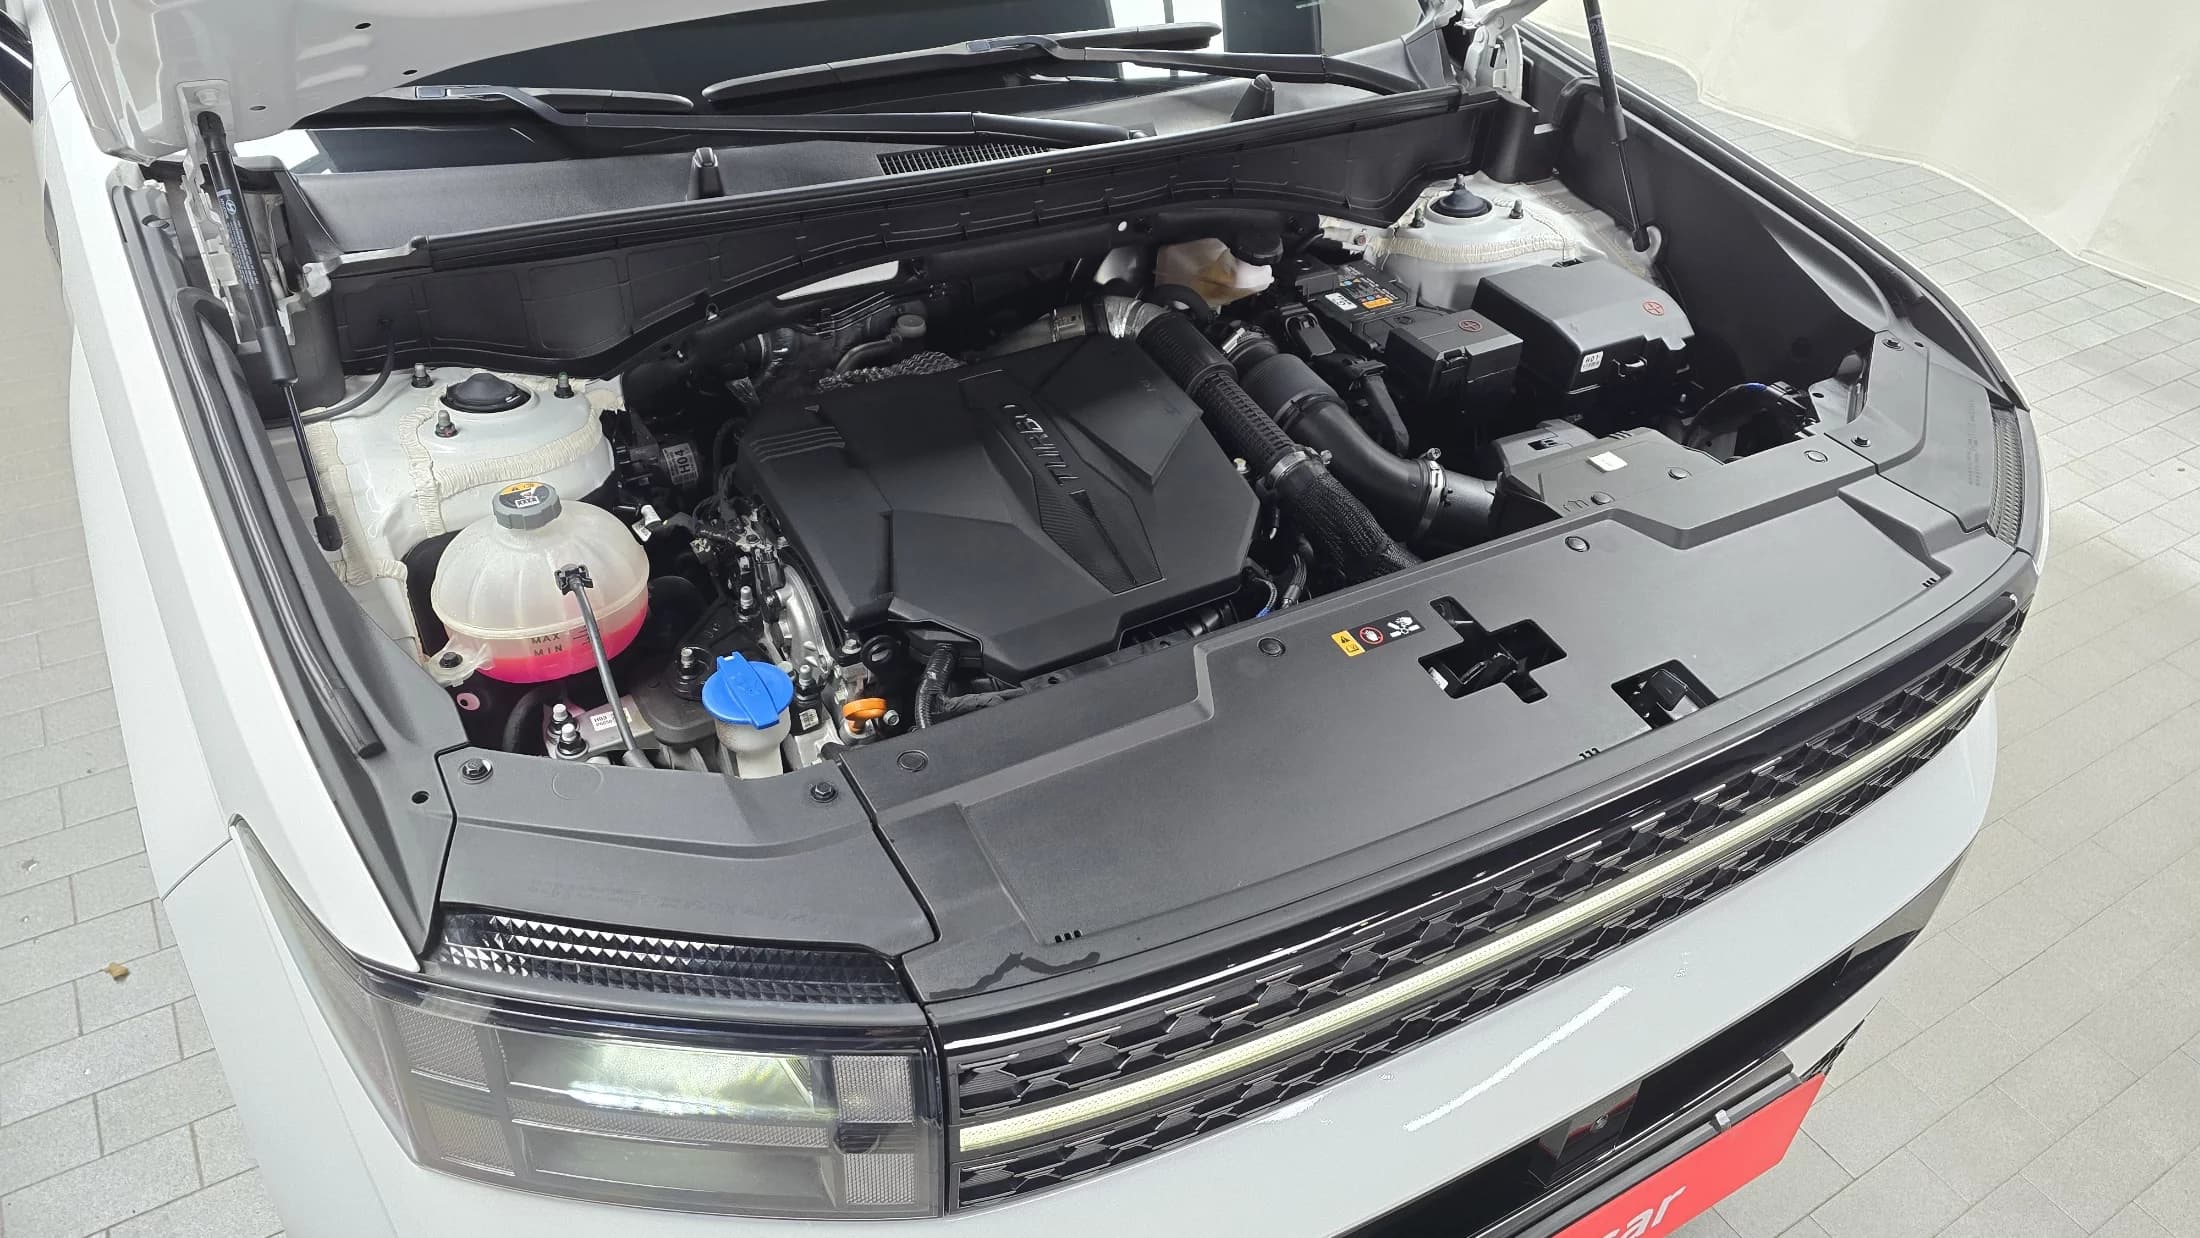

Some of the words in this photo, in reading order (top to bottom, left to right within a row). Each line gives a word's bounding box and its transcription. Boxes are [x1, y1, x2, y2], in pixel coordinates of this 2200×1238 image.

[1003, 404, 1079, 487] TURBO
[530, 632, 561, 645] MAX
[533, 644, 563, 656] MIN
[1603, 1185, 1687, 1238] ar
